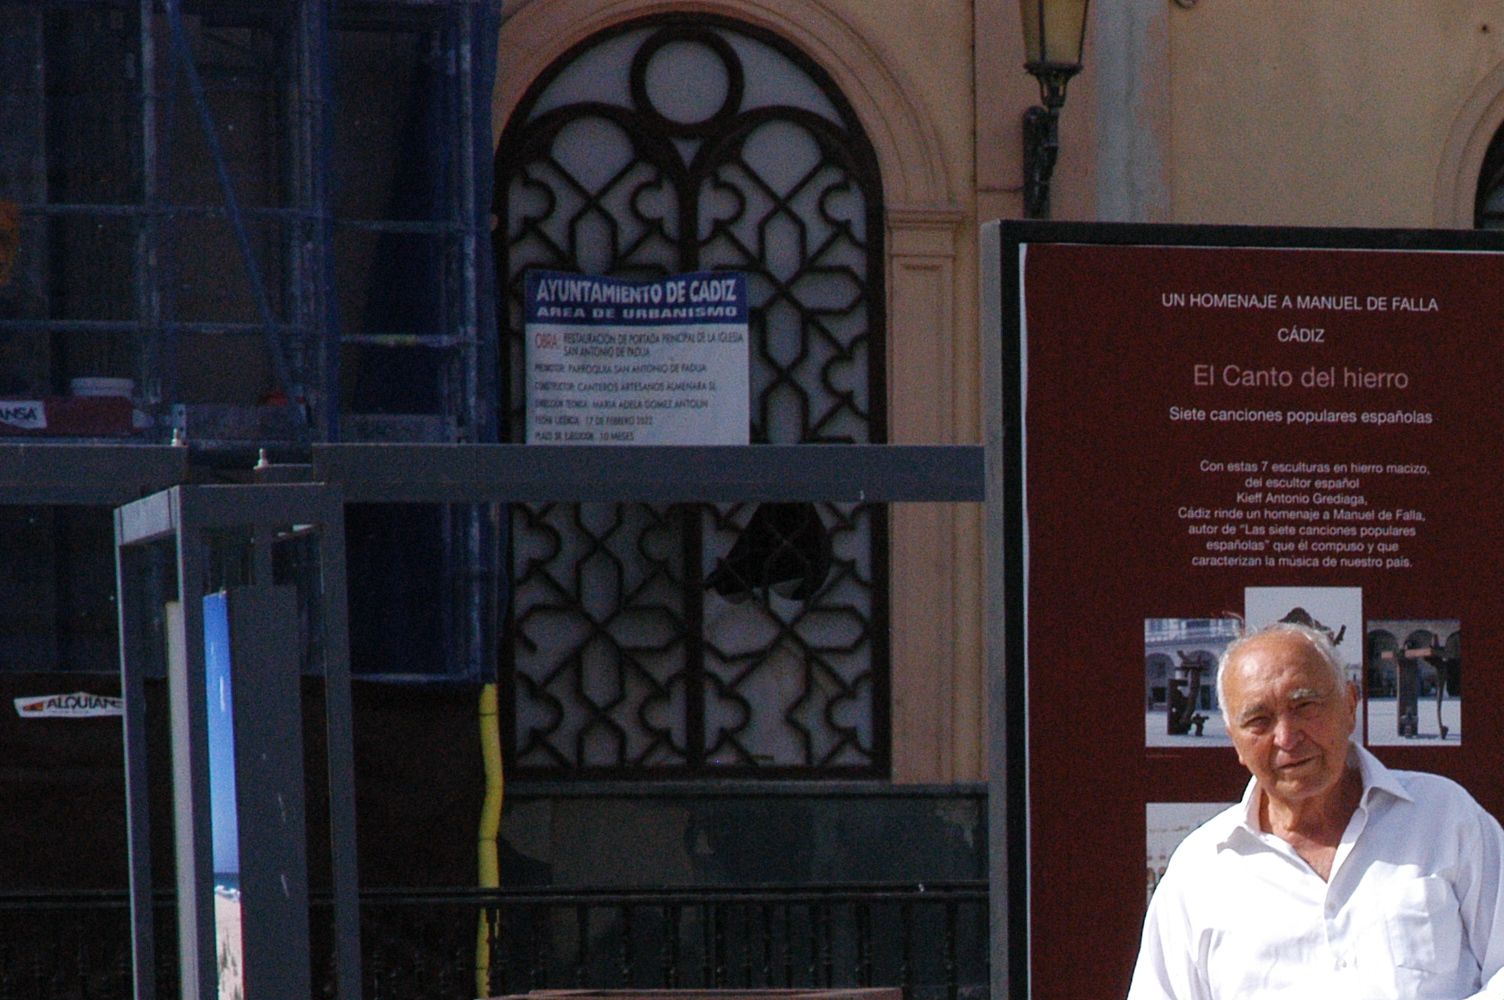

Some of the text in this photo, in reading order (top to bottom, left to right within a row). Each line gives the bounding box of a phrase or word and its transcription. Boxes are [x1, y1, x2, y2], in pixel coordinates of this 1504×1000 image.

[536, 278, 662, 304] AYUNTAMIENTO
[666, 280, 686, 304] DE
[1161, 292, 1439, 312] UN HOMENAJE A MANUEL DE FALLA
[536, 306, 738, 319] AREA DE URBANISMO
[707, 332, 716, 344] LA
[1277, 324, 1326, 343] CÁDIZ
[580, 345, 614, 358] ANTONIO
[616, 346, 625, 358] DE
[614, 364, 630, 375] SAN
[631, 364, 668, 374] ANTONIO
[670, 363, 679, 374] DE
[1193, 364, 1409, 390] El Canto del hierro
[1169, 405, 1433, 426] Siete canciones populares españolas
[1200, 460, 1430, 475] Con estas 7 esculturas en hierro macizo,
[1245, 476, 1360, 490] del escultor español
[1236, 491, 1368, 507] Kieff Antonio Grediaga,
[1178, 507, 1426, 522] Cádiz rinde un homenaje a Manuel de Falla,
[1188, 524, 1218, 535] autor
[1221, 524, 1237, 535] de
[1268, 524, 1296, 535] siete
[1299, 525, 1357, 536] canciones
[1360, 525, 1416, 538] populares
[1272, 542, 1295, 553] que
[1297, 541, 1308, 552] él
[1311, 542, 1364, 553] compuso
[1367, 543, 1375, 554] y
[1377, 542, 1399, 553] que
[1191, 555, 1262, 566] caracterizan
[1265, 556, 1275, 567] la
[1278, 555, 1319, 567] música
[1322, 556, 1337, 567] de
[1340, 557, 1383, 568] nuestro
